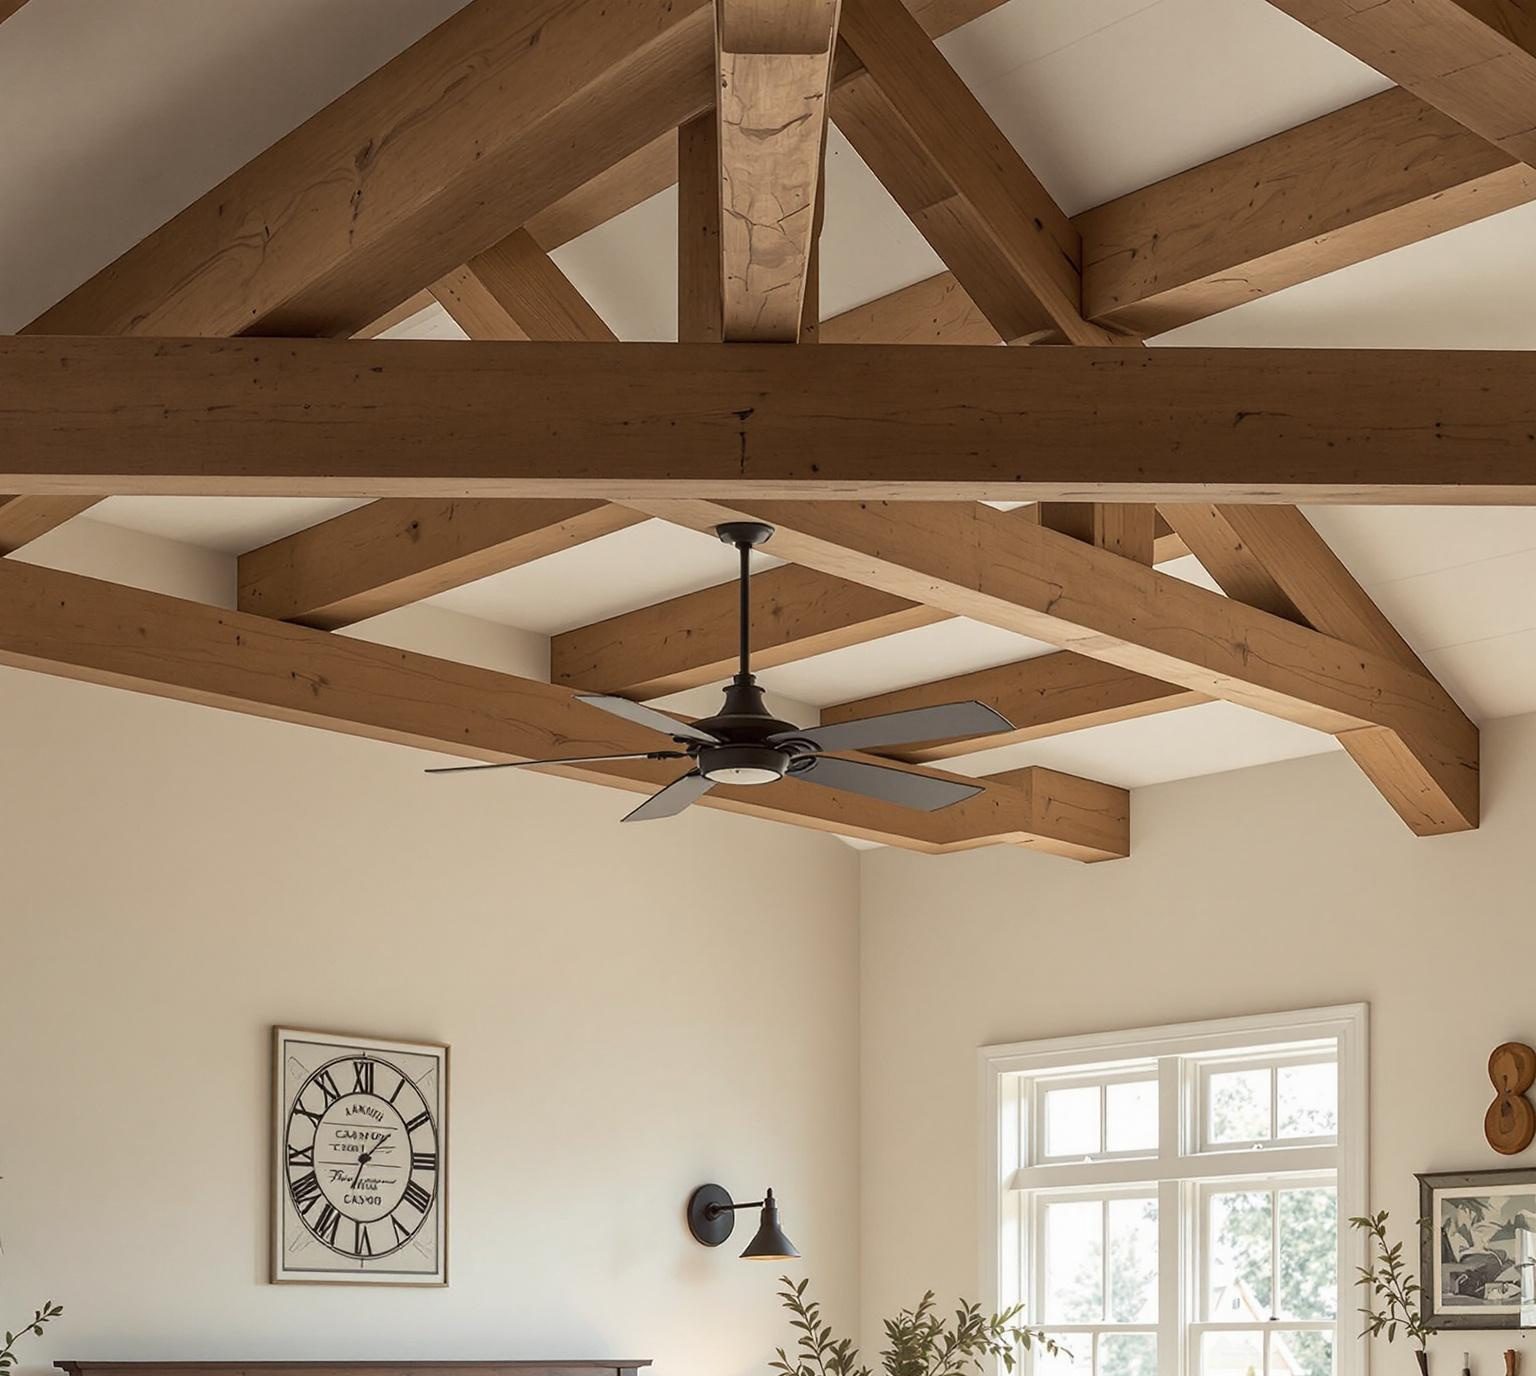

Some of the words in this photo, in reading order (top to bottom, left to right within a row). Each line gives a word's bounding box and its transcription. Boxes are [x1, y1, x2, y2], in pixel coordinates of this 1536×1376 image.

[313, 1070, 341, 1109] XI
[353, 1061, 374, 1094] XII
[294, 1098, 323, 1129] X
[406, 1111, 430, 1133] II
[413, 1153, 436, 1170] III
[390, 1214, 411, 1245] V
